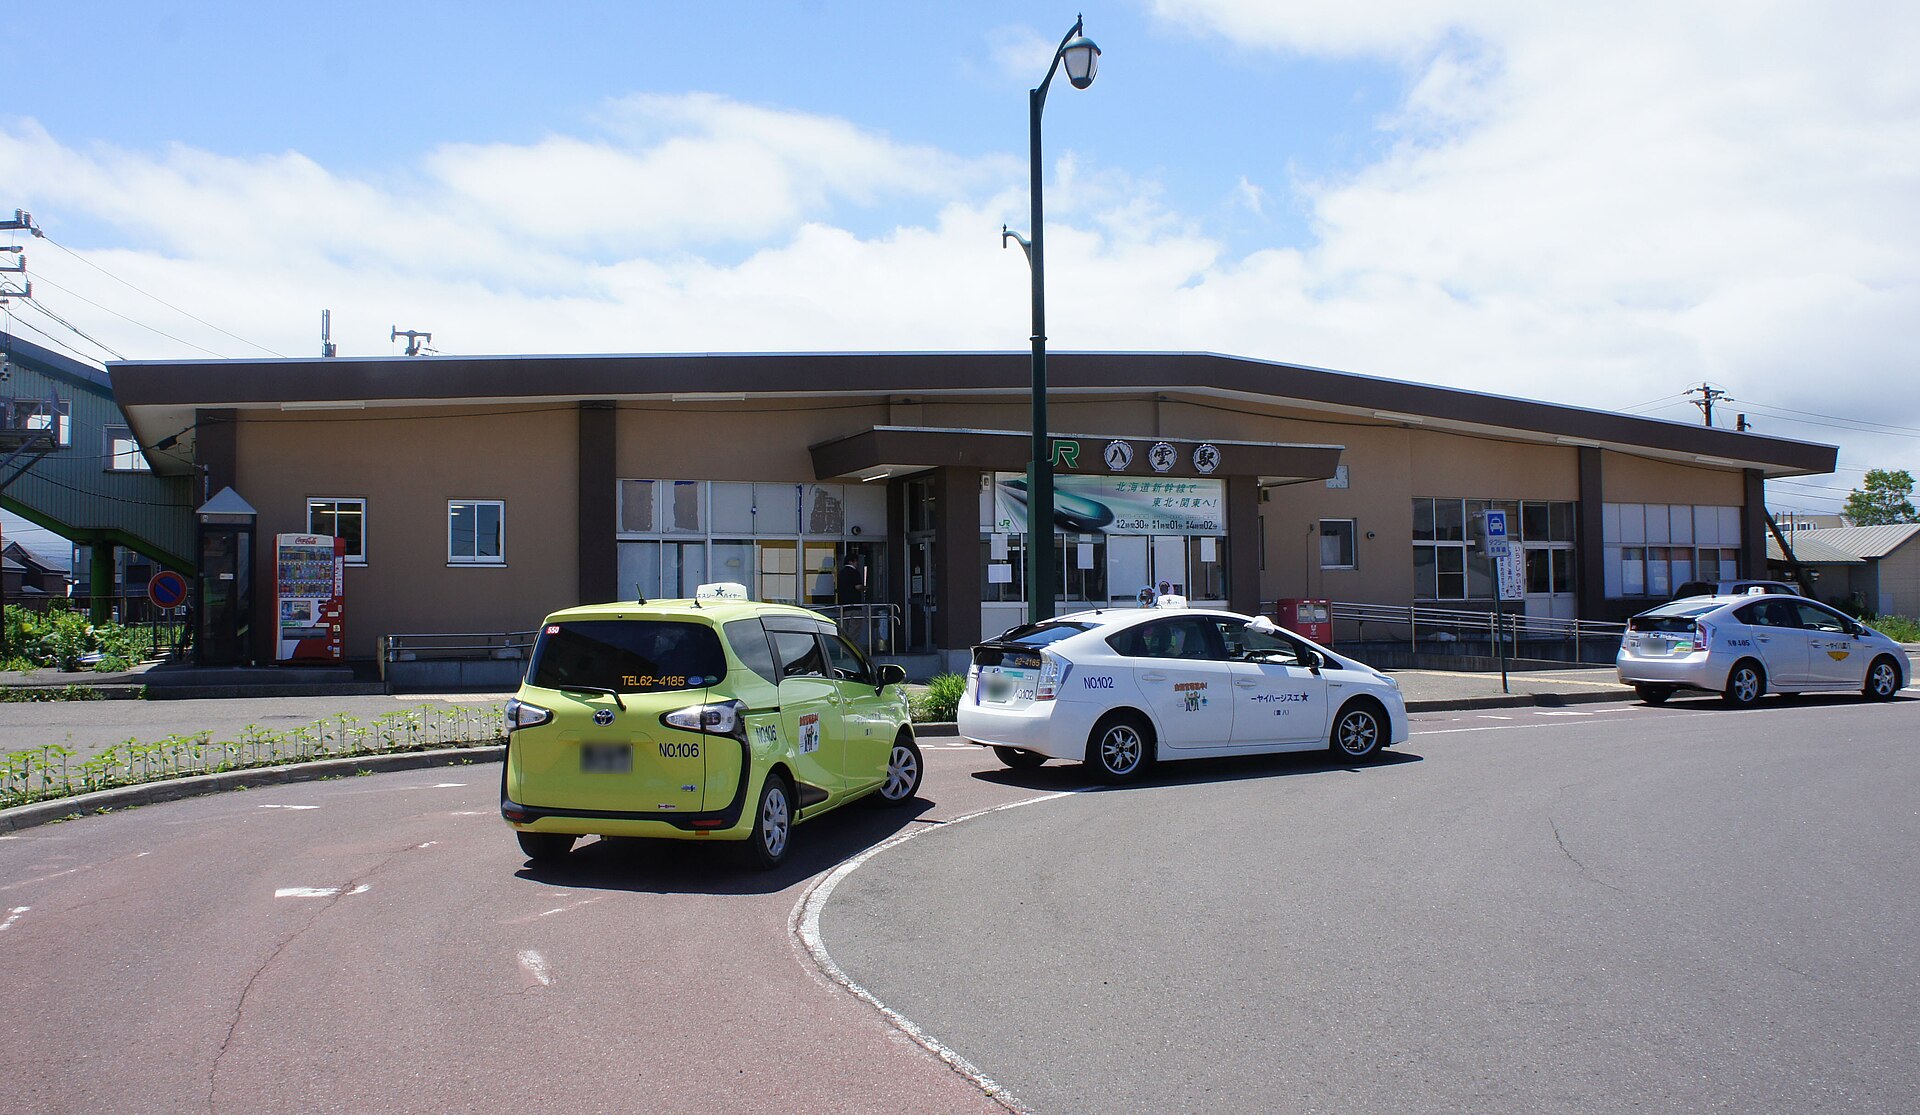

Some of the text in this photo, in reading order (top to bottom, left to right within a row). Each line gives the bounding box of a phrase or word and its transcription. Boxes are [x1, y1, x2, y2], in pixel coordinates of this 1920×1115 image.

[1048, 439, 1080, 469] JR
[1108, 444, 1217, 469] 八雲駅
[1115, 481, 1197, 493] 北海道新幹線で
[999, 519, 1011, 527] JR
[547, 626, 560, 634] 550
[622, 675, 685, 687] TEL62-4185
[1083, 676, 1114, 689] NO.102
[658, 743, 699, 758] NO.106
